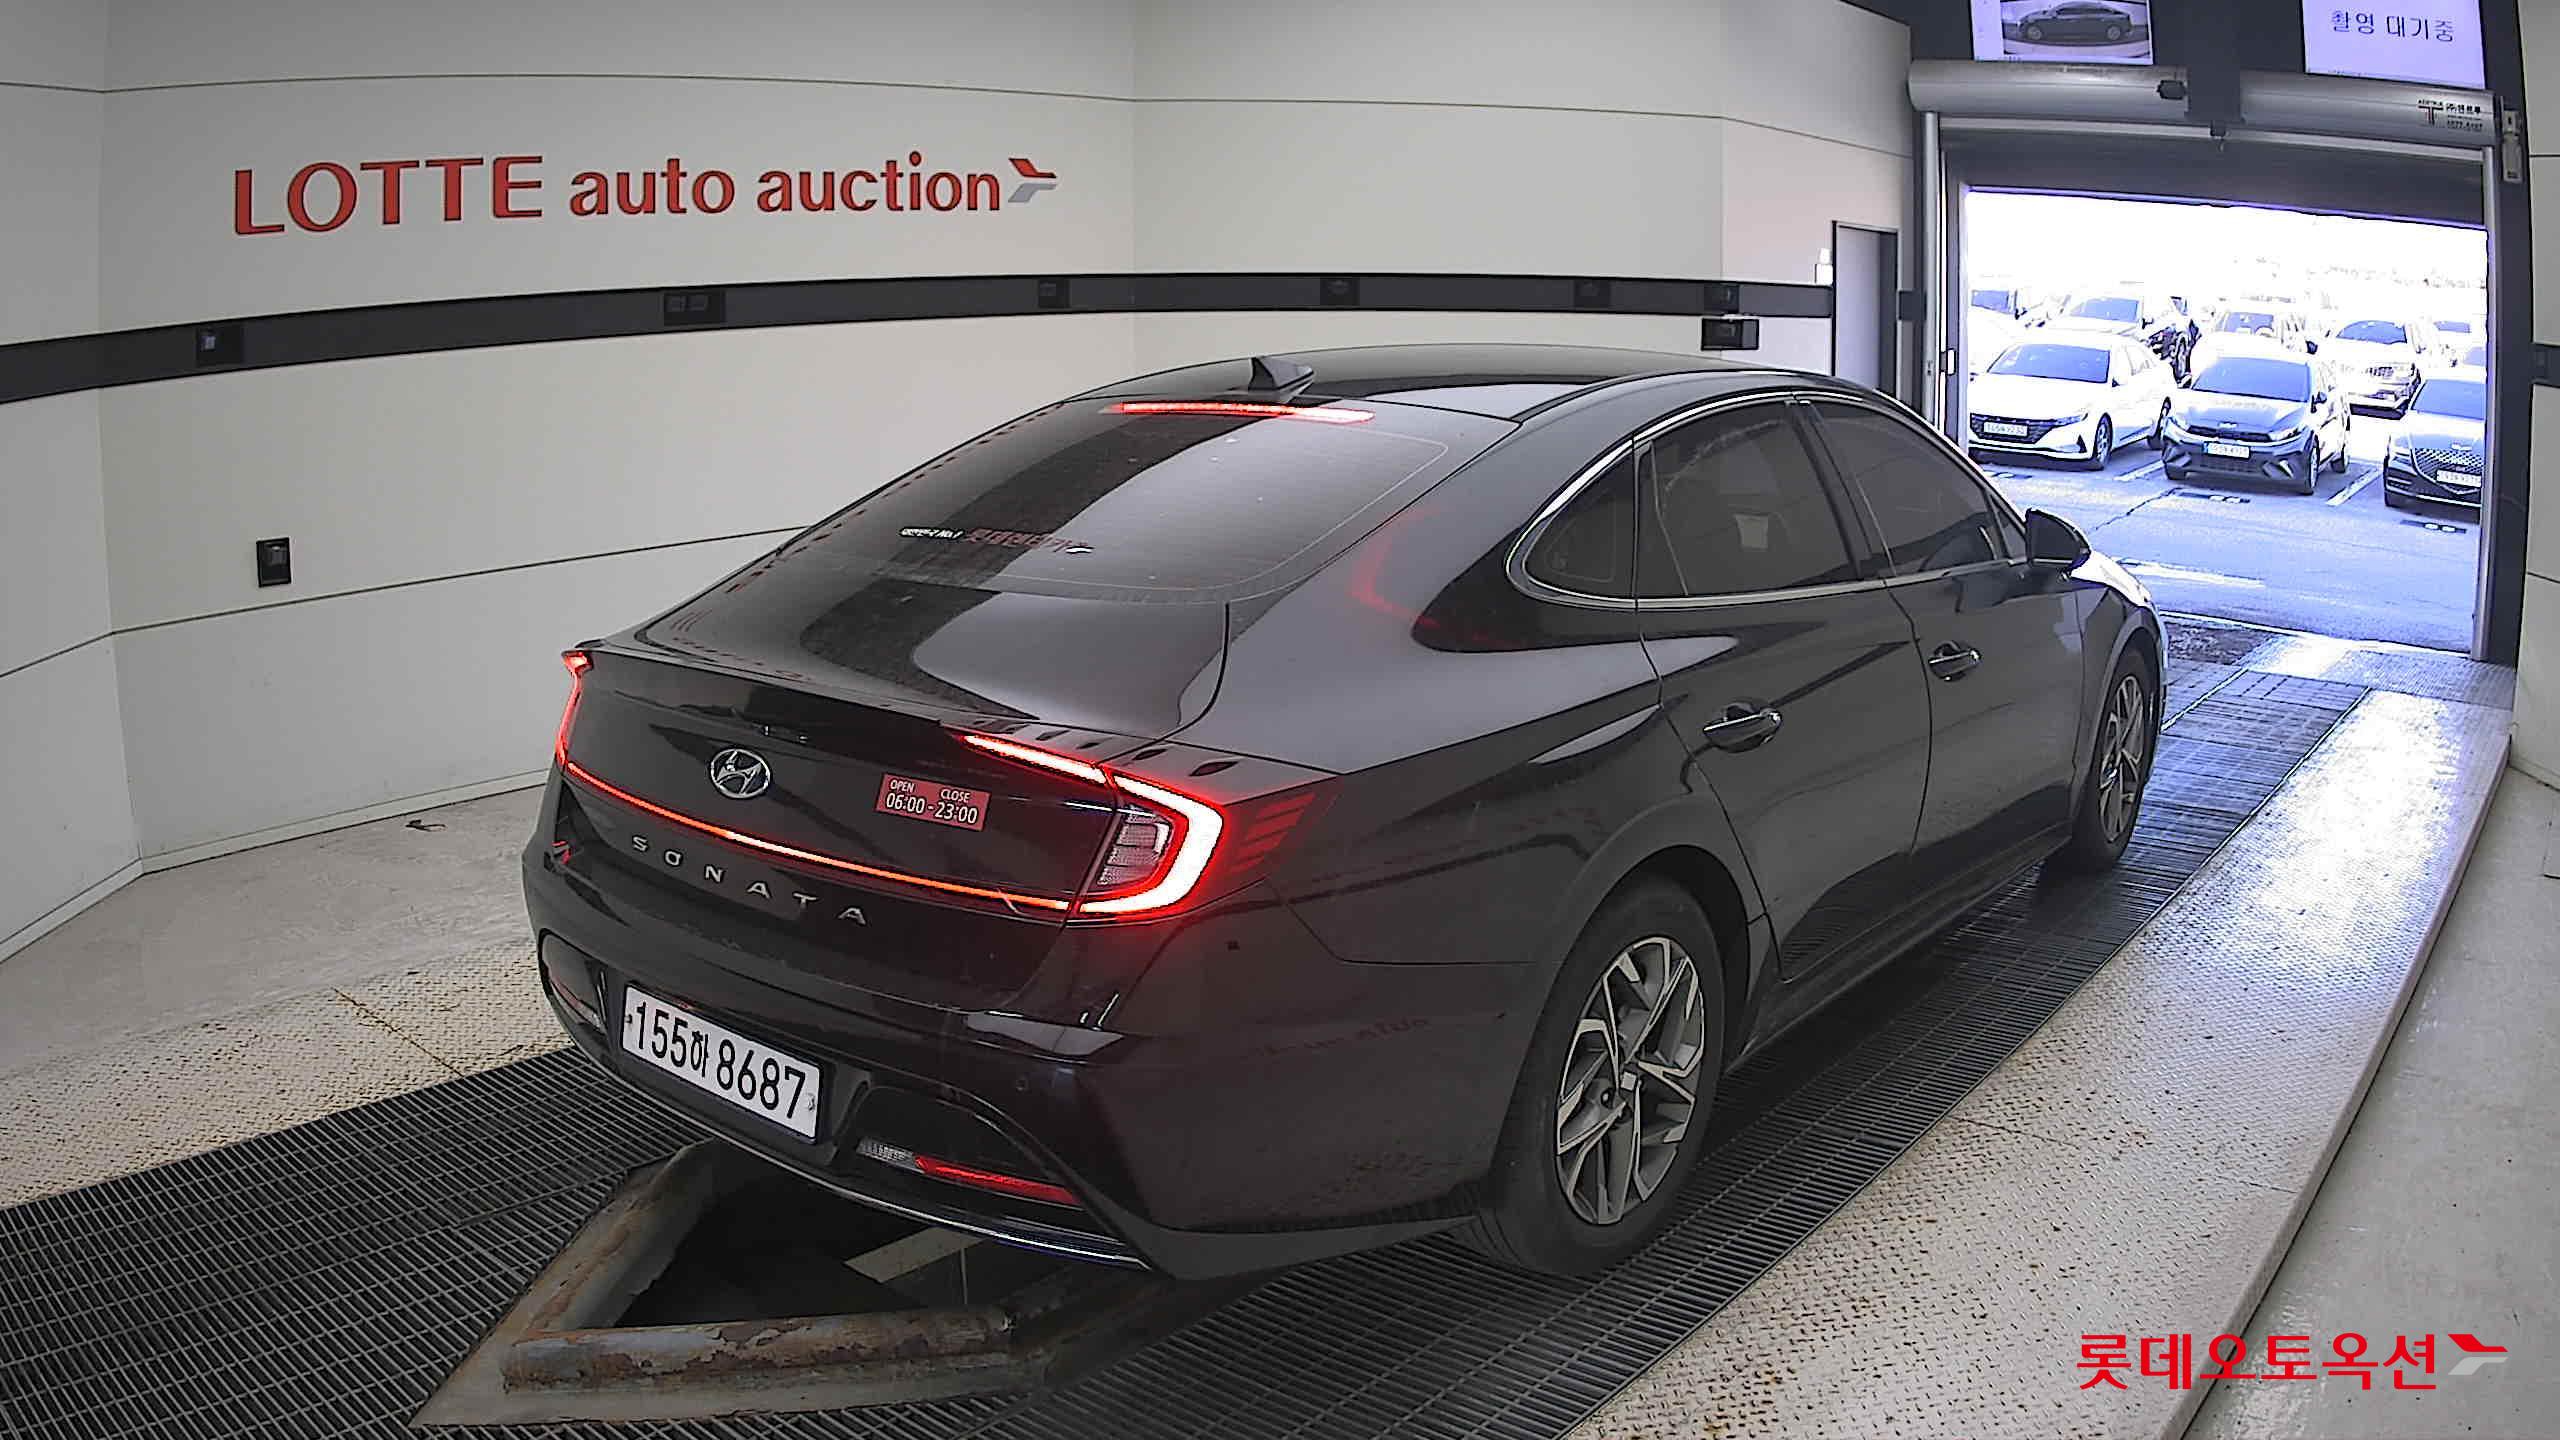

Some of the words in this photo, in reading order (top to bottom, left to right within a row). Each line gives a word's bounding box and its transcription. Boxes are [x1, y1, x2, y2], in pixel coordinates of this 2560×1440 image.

[2386, 15, 2454, 43] 대기중
[234, 154, 543, 236] LOTTE
[569, 157, 736, 217] auto
[756, 150, 1001, 213] auction
[889, 779, 915, 793] OPEN
[940, 788, 971, 803] CLOSE
[631, 834, 867, 926] SONATA
[636, 1001, 710, 1078] 155하
[716, 1038, 806, 1119] 8687
